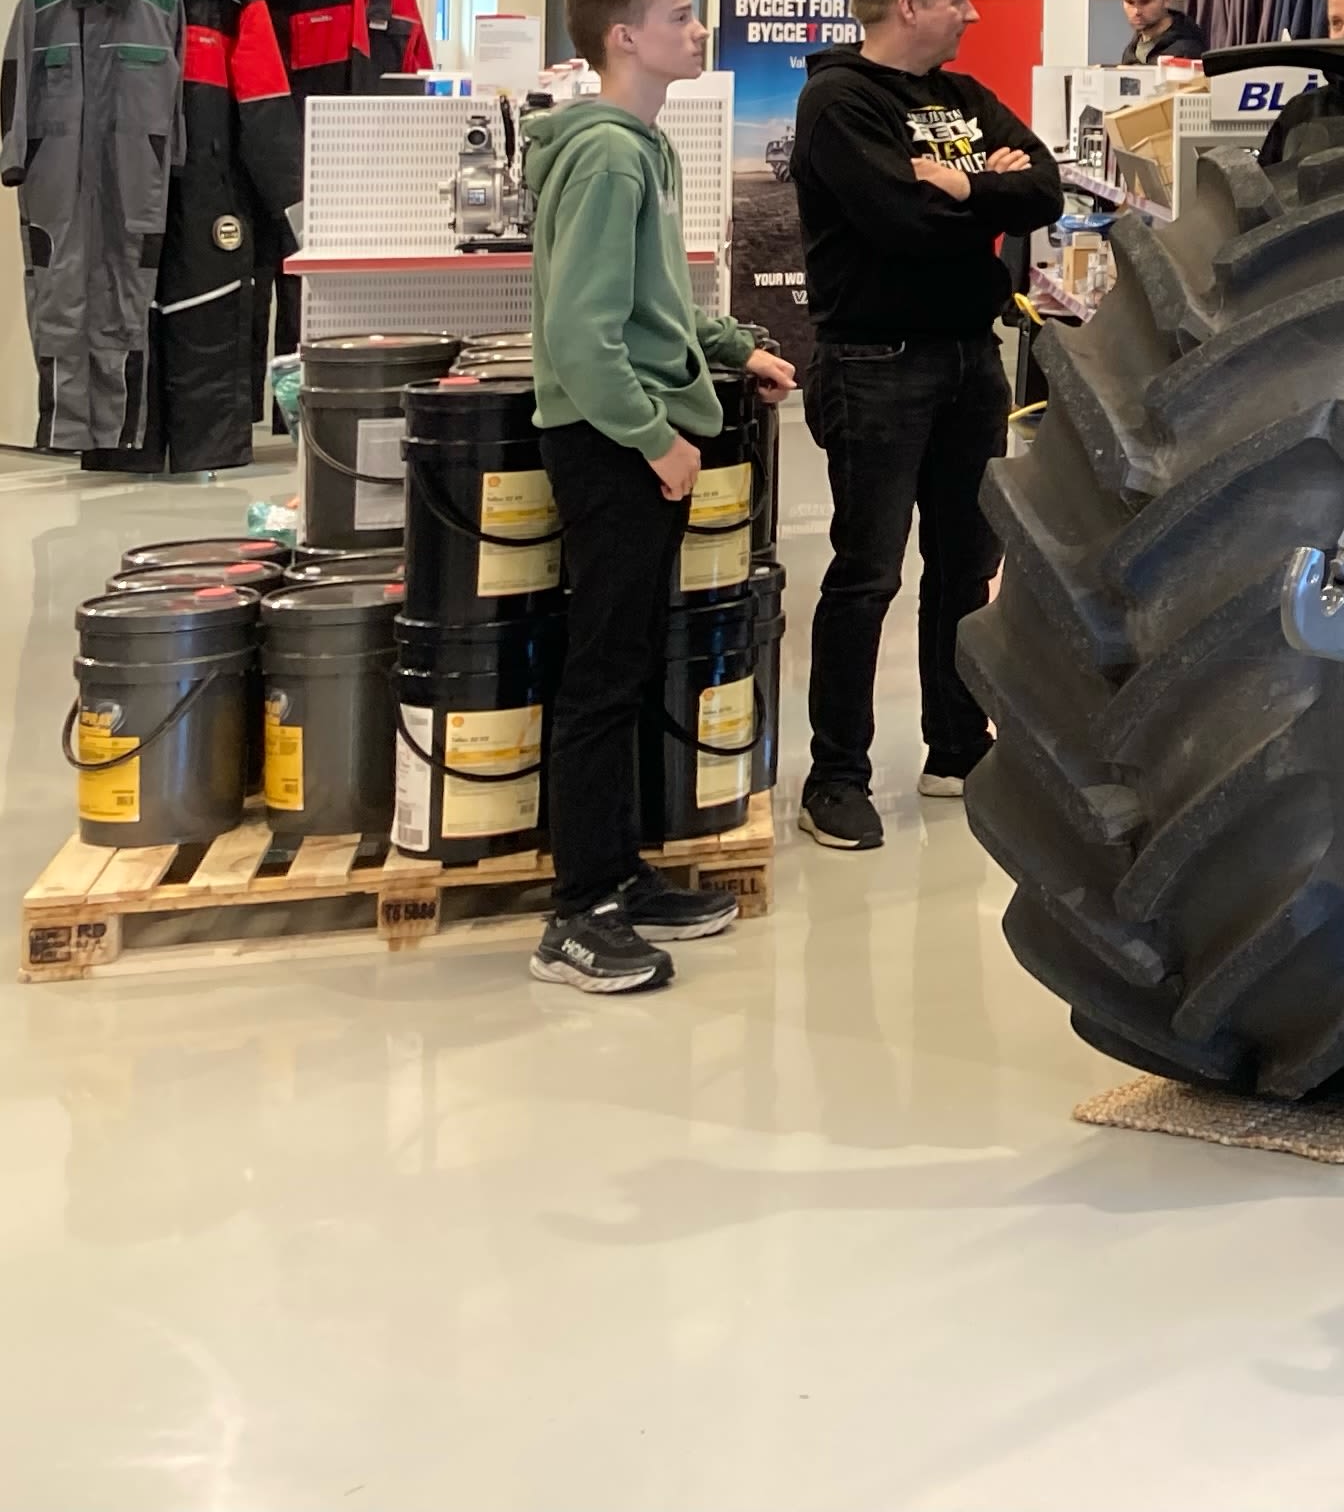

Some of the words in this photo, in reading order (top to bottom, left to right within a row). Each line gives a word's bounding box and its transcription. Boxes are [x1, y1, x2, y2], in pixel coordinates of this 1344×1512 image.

[747, 22, 818, 43] BYGGET
[821, 23, 857, 44] FOR
[790, 56, 806, 69] Val
[754, 273, 784, 286] YOUR
[784, 272, 806, 285] WO
